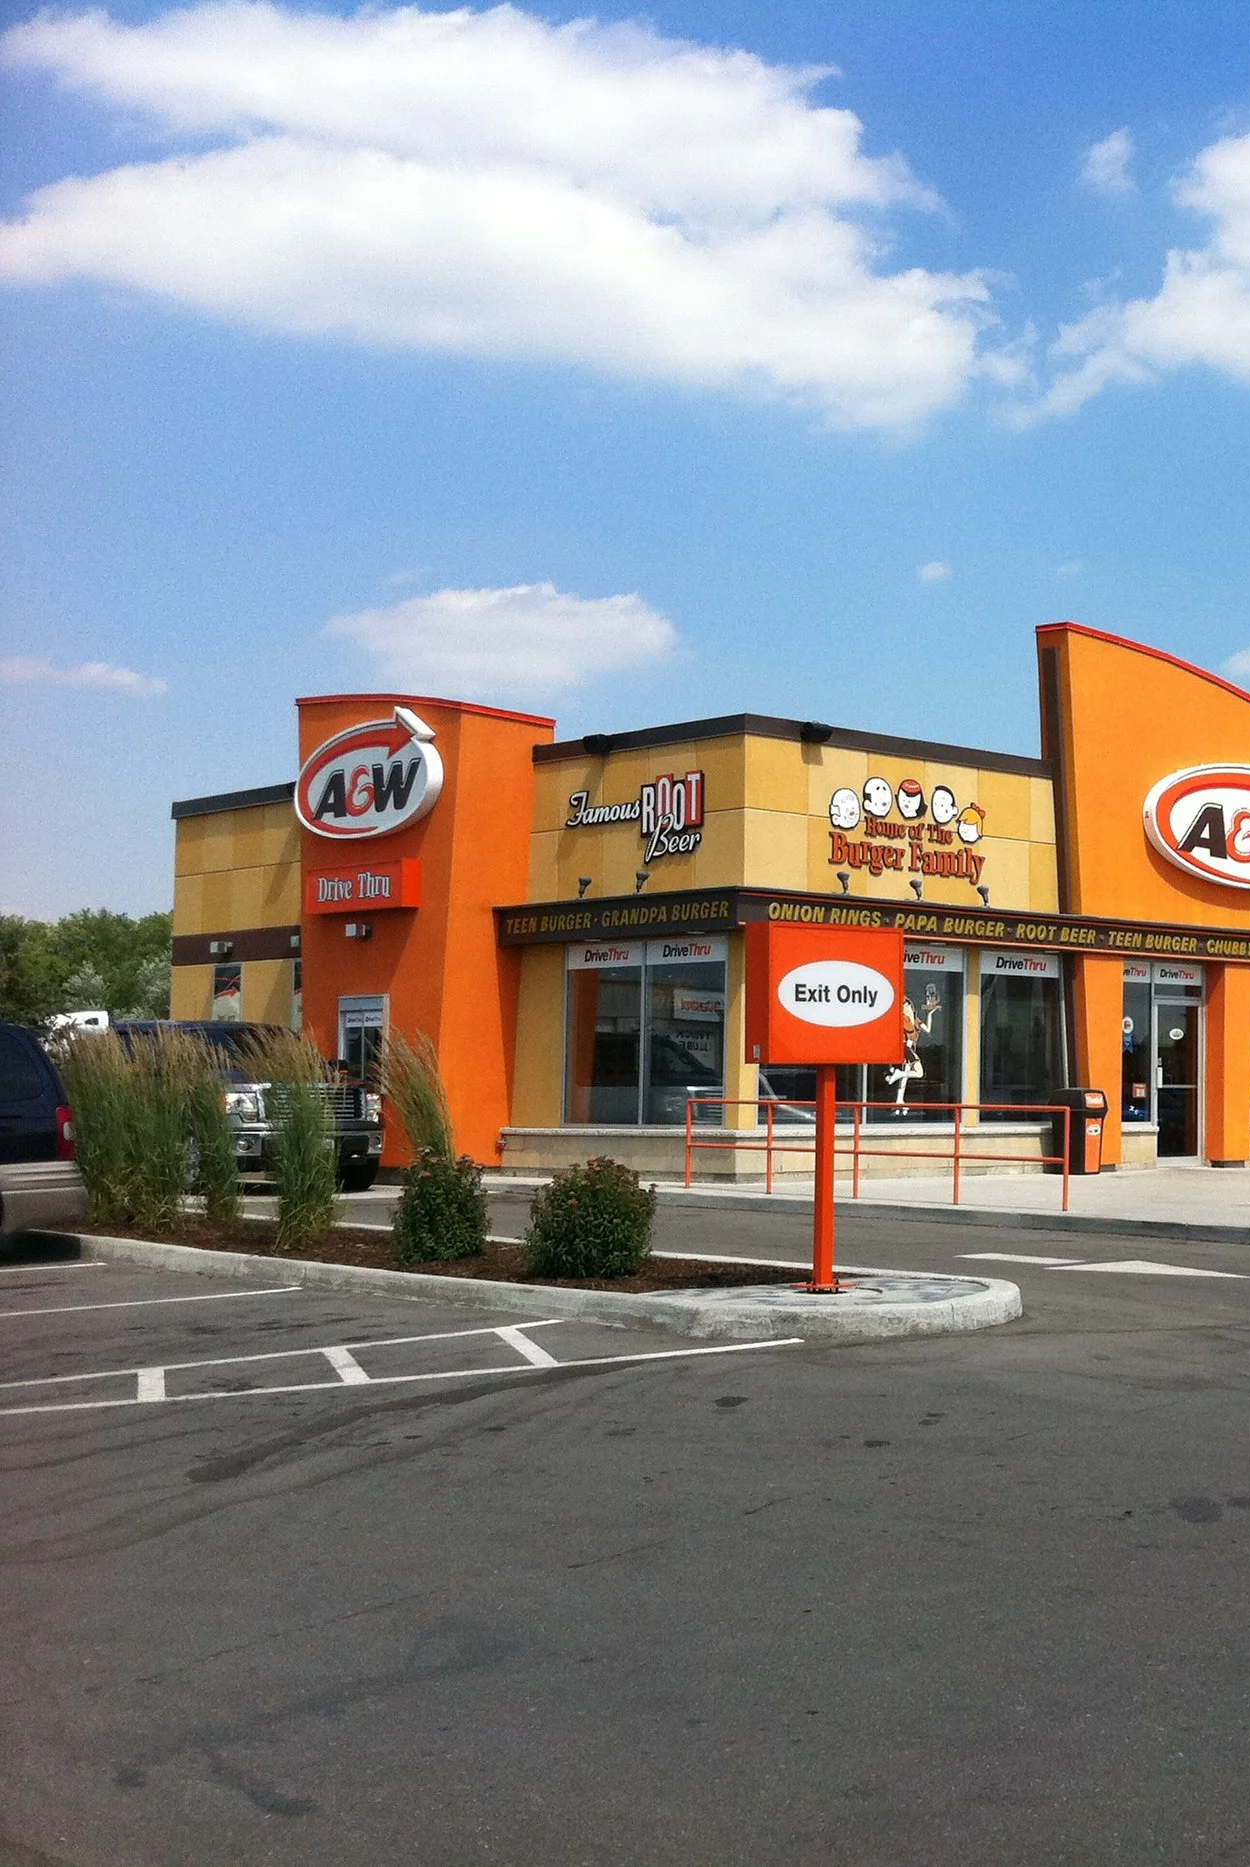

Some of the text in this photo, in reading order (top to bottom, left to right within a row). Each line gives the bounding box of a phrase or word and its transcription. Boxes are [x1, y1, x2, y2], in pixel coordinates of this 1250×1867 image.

[313, 757, 422, 821] A&W
[566, 771, 703, 836] Famous ROOT
[644, 813, 701, 864] Beer
[864, 816, 954, 844] Home of The
[828, 831, 985, 885] Burger Family
[318, 871, 391, 904] Drive Thru
[506, 900, 729, 935] TEEN BURGER GRANDPA BURGER
[768, 902, 825, 922] ONION
[830, 908, 882, 927] RINGS
[894, 913, 938, 931] PAPA
[943, 917, 1005, 938] BURGER
[1016, 924, 1057, 941] ROOT
[1060, 927, 1097, 944] BEER
[1108, 931, 1142, 948] TEEN
[1145, 934, 1198, 953] BURGER
[794, 983, 878, 1008] Exit Only
